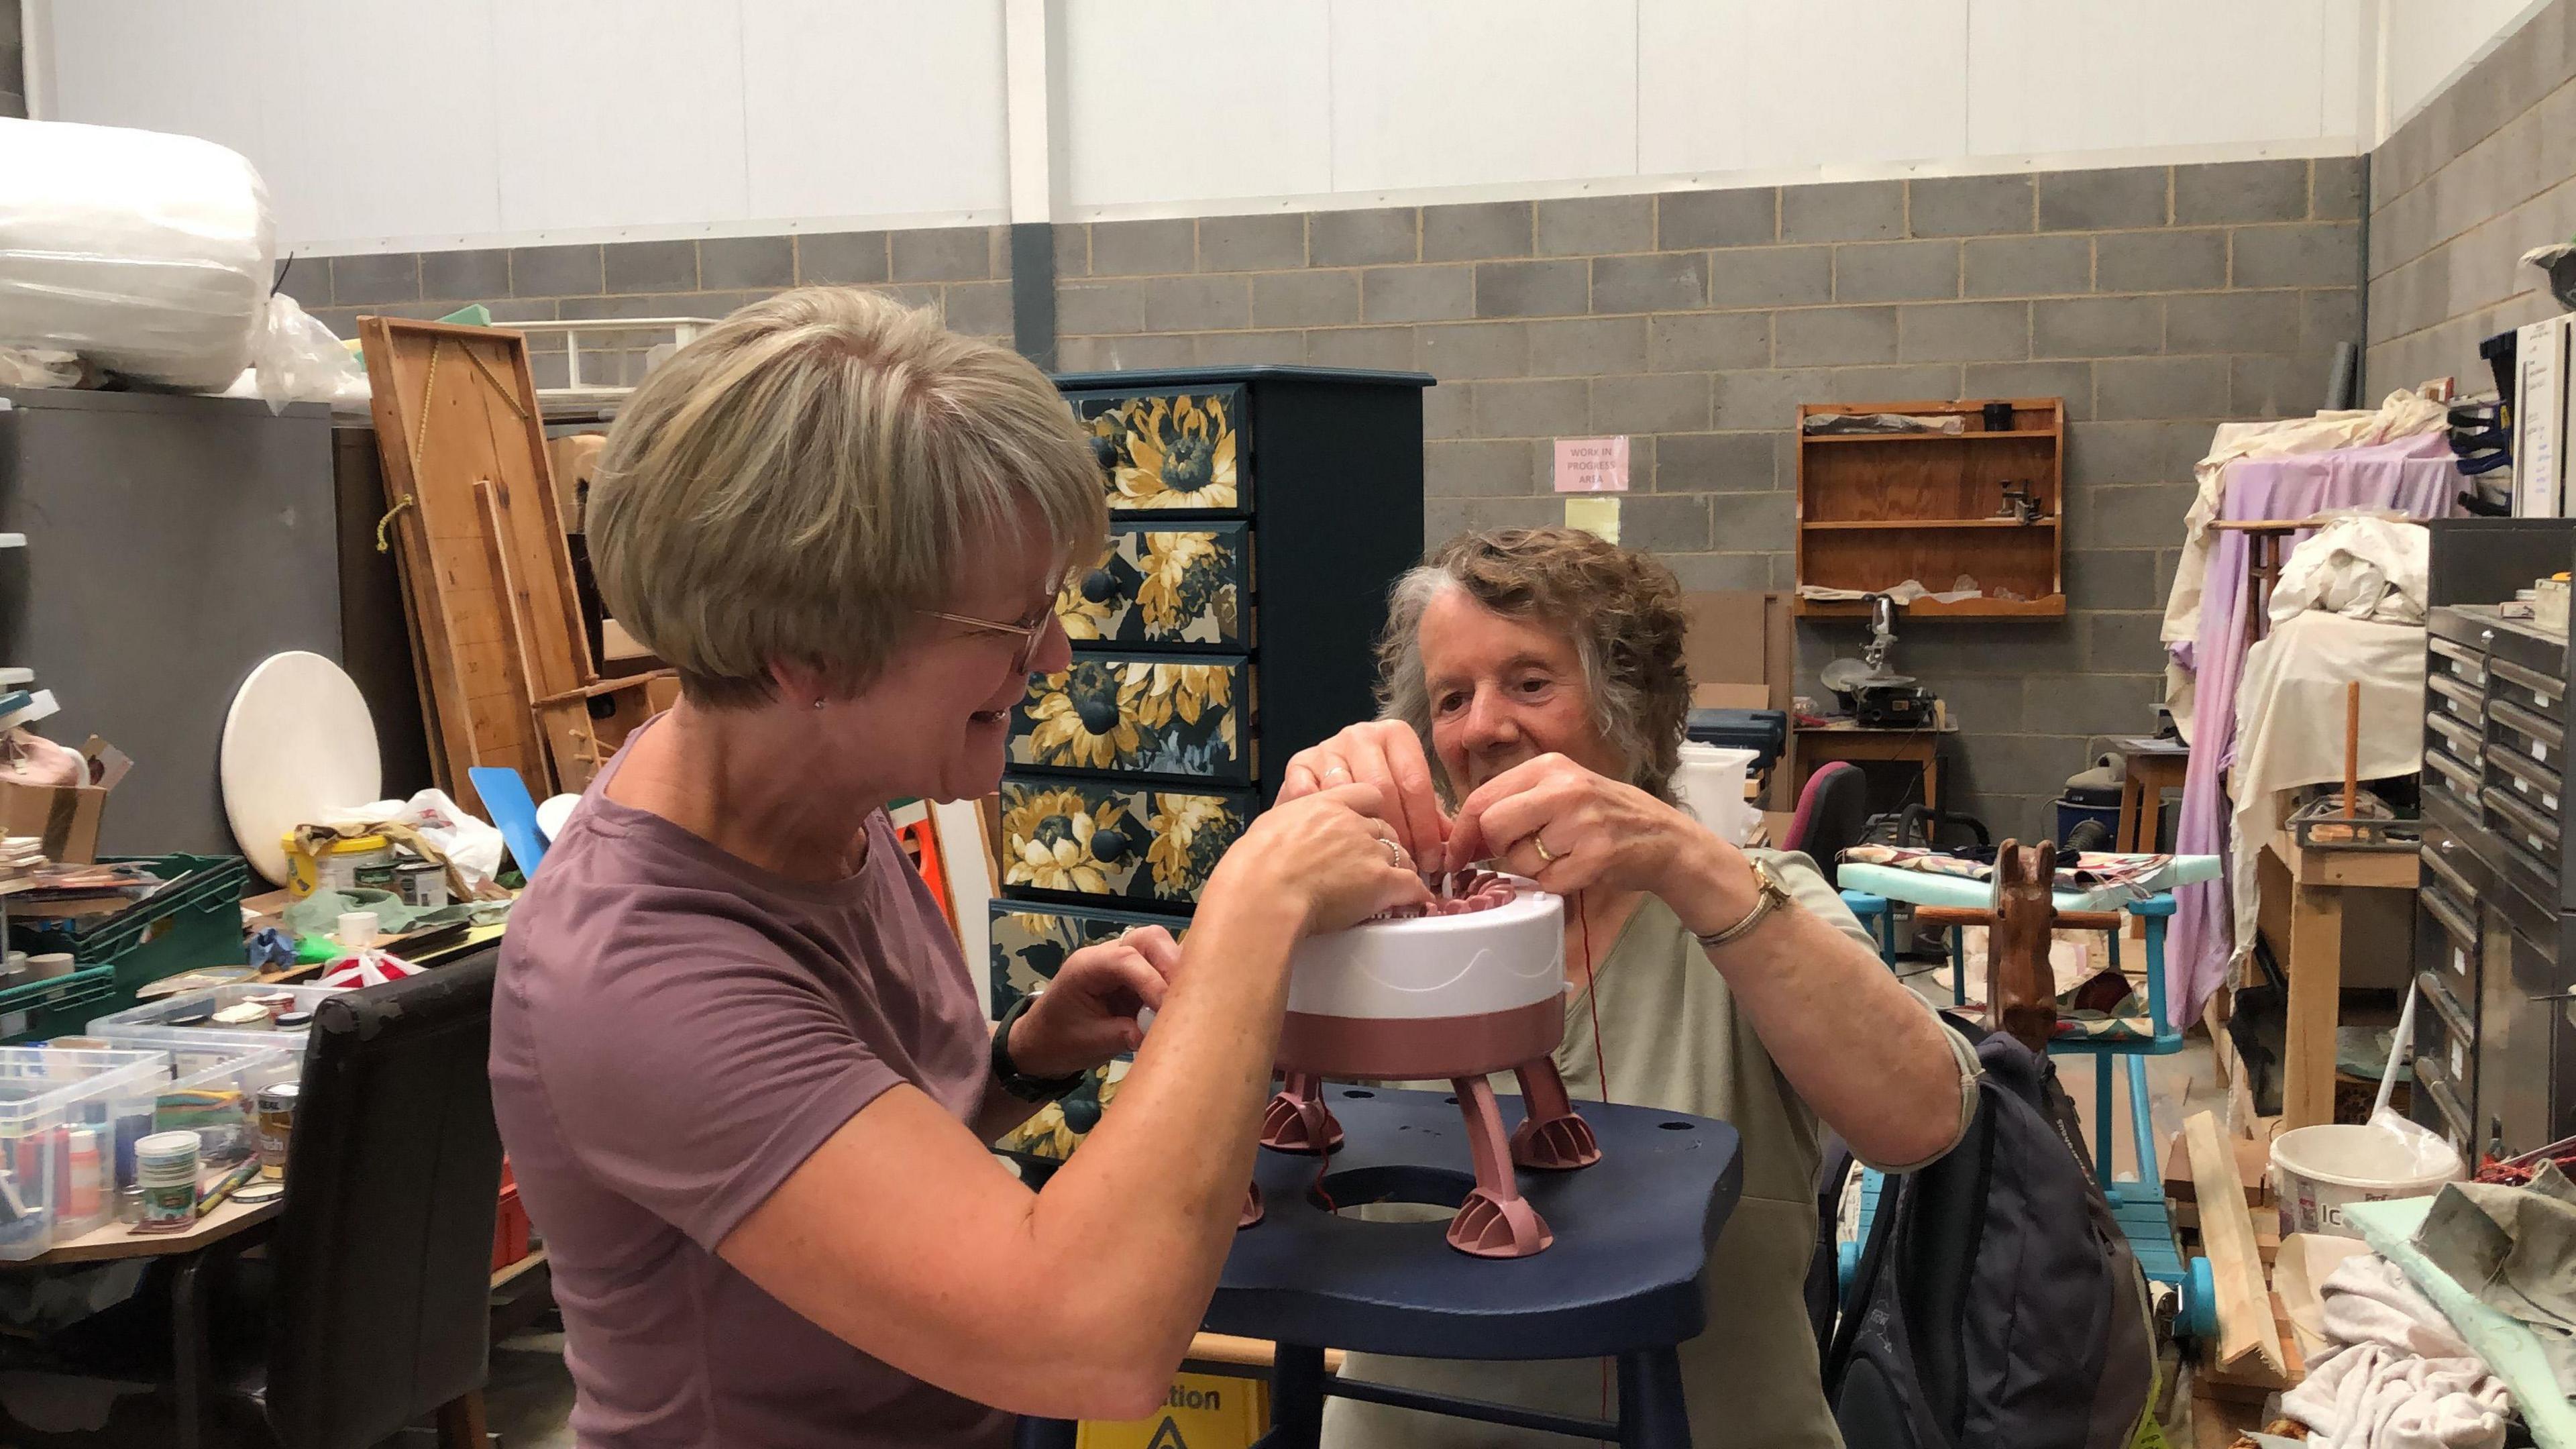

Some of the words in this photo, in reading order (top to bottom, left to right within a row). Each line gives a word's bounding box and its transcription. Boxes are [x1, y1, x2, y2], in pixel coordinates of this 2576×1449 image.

[1570, 448, 1599, 456] WORK
[1567, 461, 1615, 470] PROGRESS
[1578, 475, 1604, 484] AREA
[1169, 1385, 1220, 1410] tion
